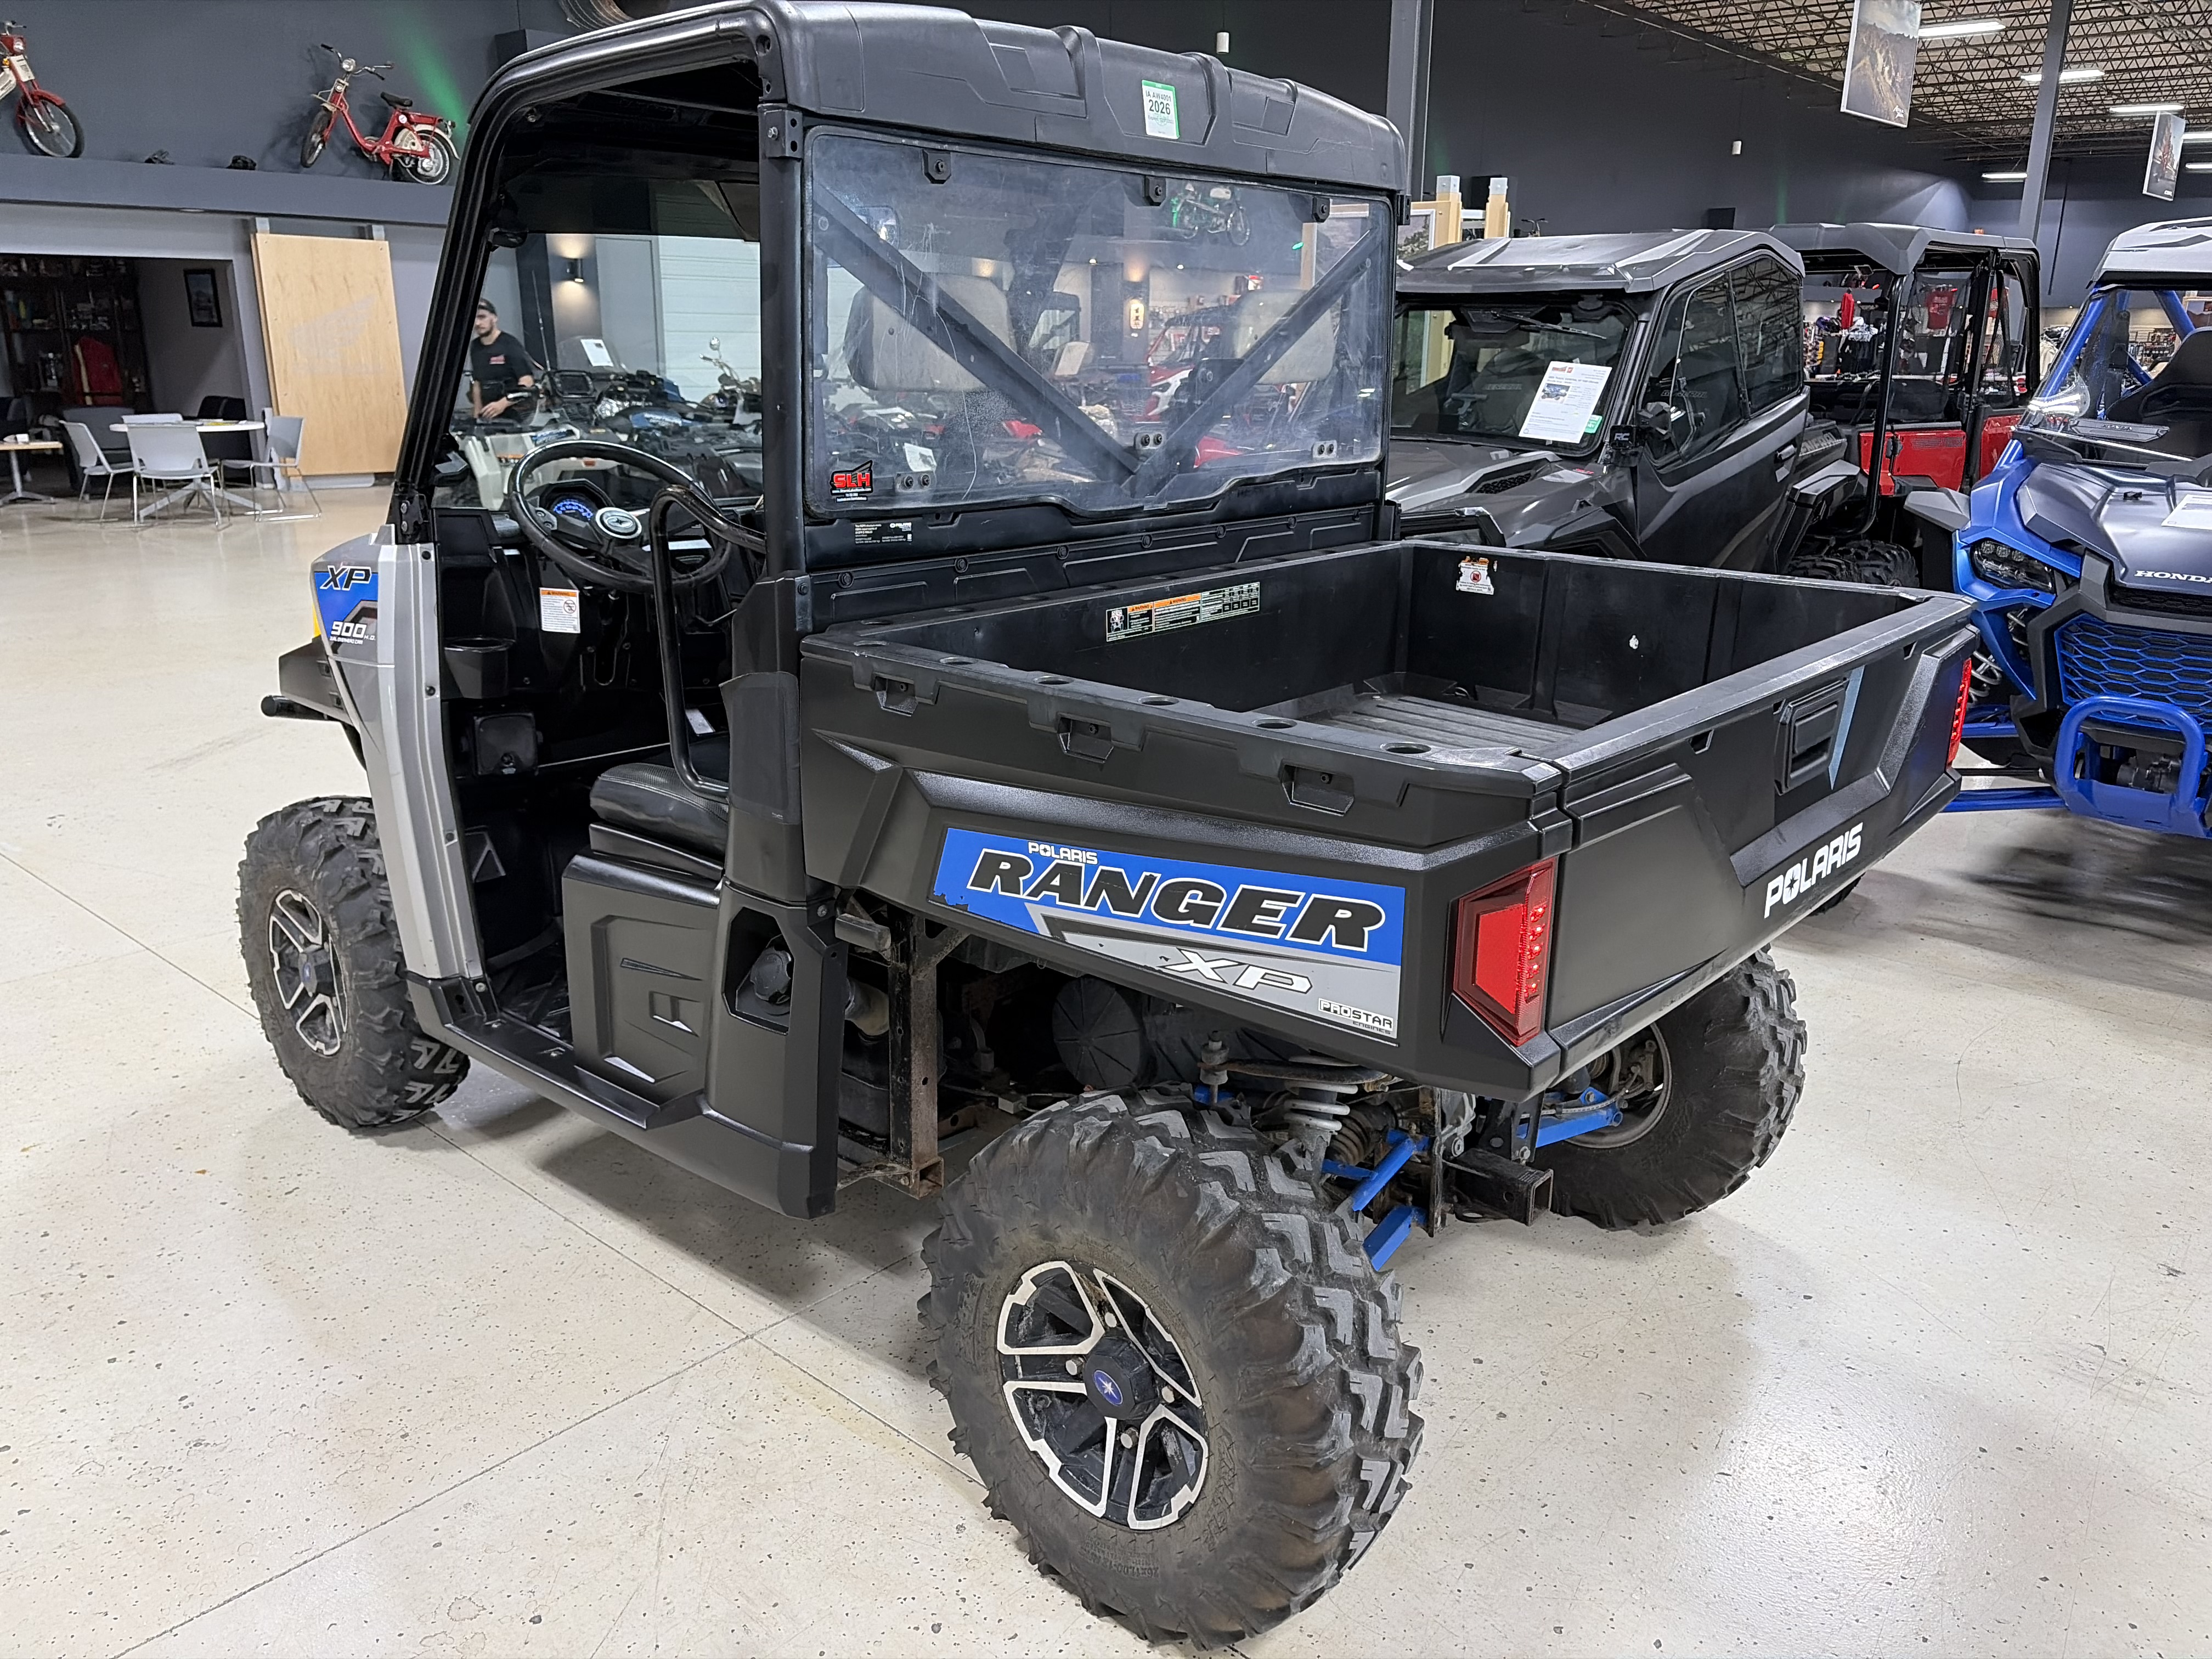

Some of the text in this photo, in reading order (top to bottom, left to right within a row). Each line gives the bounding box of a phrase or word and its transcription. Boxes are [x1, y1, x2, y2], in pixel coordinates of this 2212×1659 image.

[1146, 90, 1151, 98] IA
[1148, 99, 1171, 115] 2026
[1614, 432, 1630, 441] RC
[833, 473, 871, 489] SLH
[320, 565, 373, 591] XP
[331, 621, 367, 638] 900
[1028, 841, 1098, 865] POLARIS
[1764, 822, 1864, 919] POLARIS
[966, 848, 1386, 953] RANGER
[1160, 947, 1313, 994] XP
[1319, 999, 1392, 1029] PROSTAR
[1352, 1020, 1391, 1035] ENGINES
